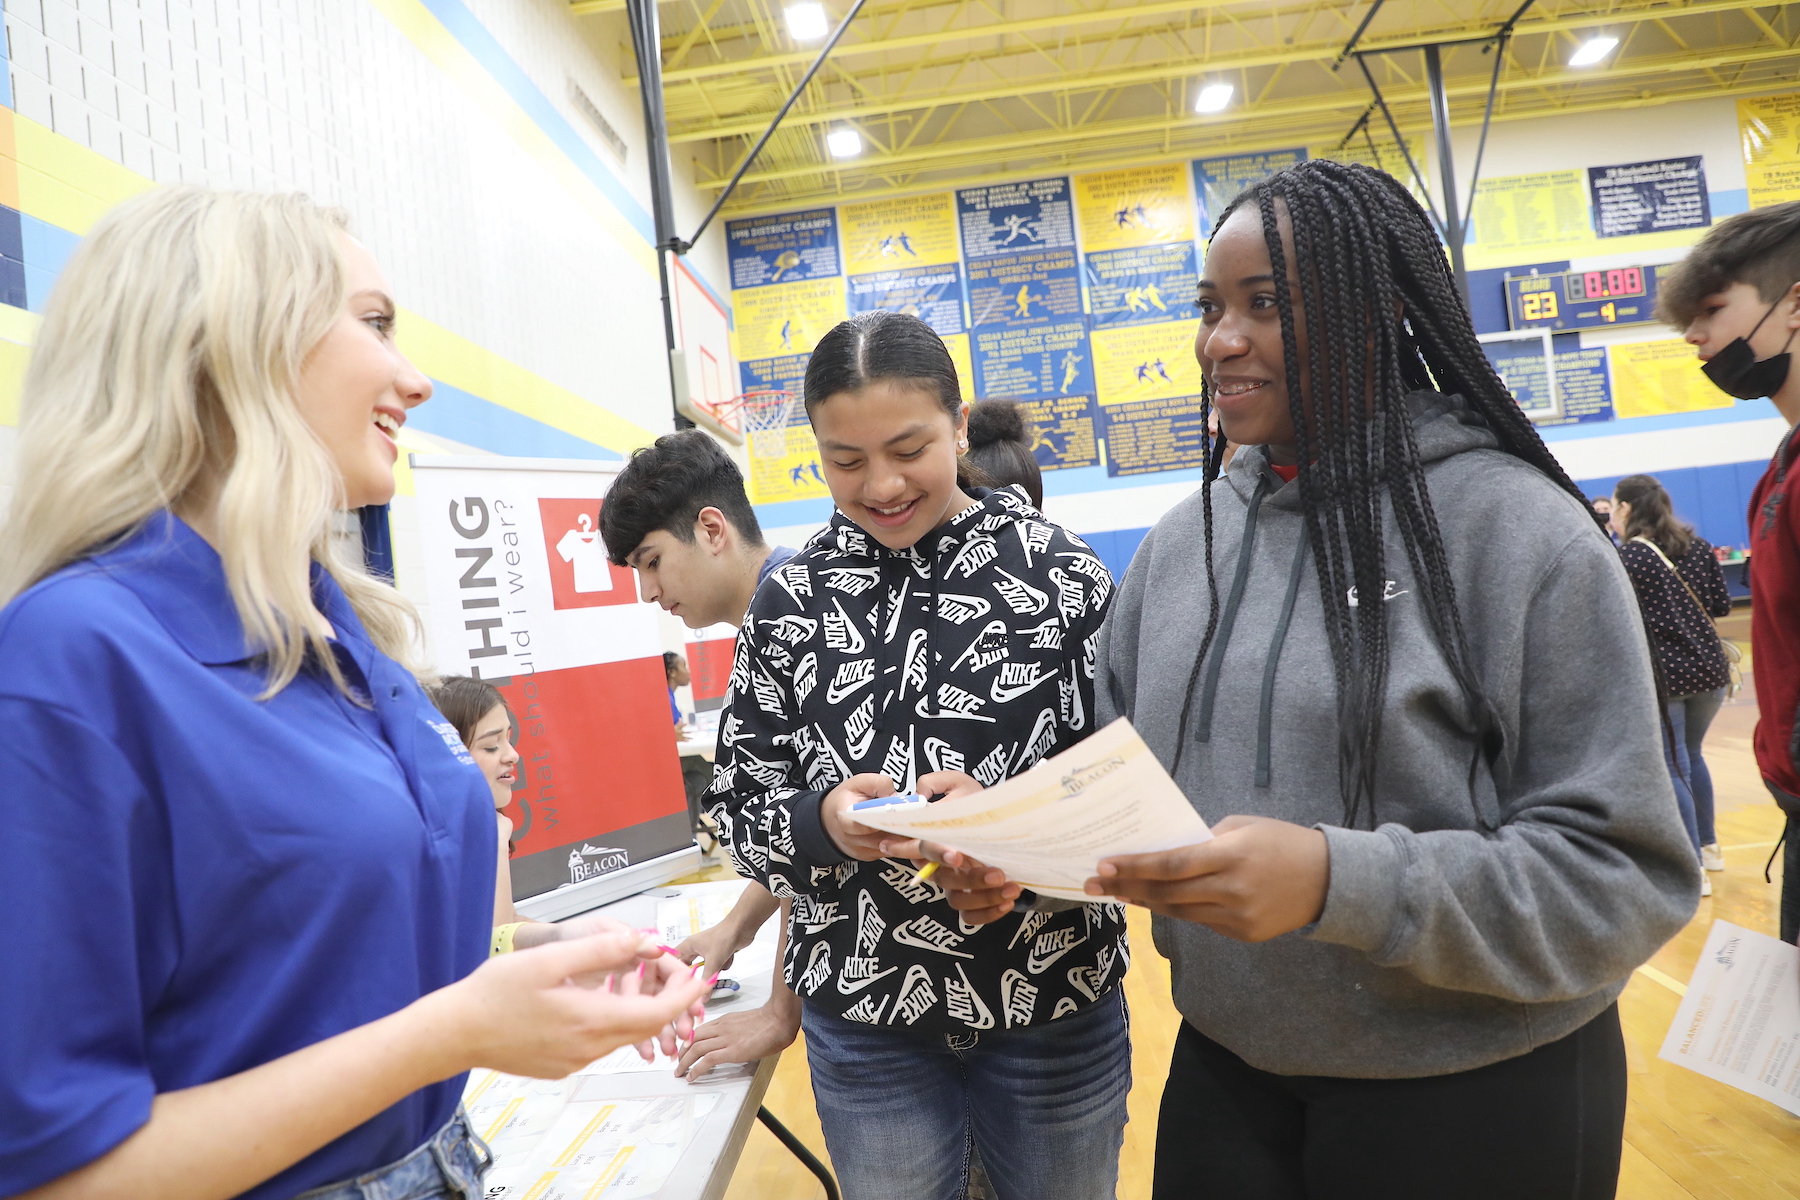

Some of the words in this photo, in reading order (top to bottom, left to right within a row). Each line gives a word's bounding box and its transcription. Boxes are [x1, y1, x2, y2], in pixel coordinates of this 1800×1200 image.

[751, 223, 791, 235] DISTRICT
[793, 218, 831, 231] CHAMPS
[991, 264, 1033, 277] DISTRICT
[1035, 259, 1075, 271] CHAMPS
[1018, 254, 1044, 263] JUNIOR
[1045, 251, 1073, 259] SCHOOL
[917, 273, 956, 286] CHAMPS
[1522, 291, 1558, 320] 23
[1600, 302, 1616, 323] 4
[1000, 336, 1042, 348] DISTRICT
[1044, 331, 1085, 343] CHAMPS
[1028, 326, 1054, 335] JUNIOR
[1055, 322, 1083, 332] SCHOOL
[1126, 409, 1159, 421] DISTRICT
[494, 499, 524, 595] wear?
[1028, 523, 1054, 554] NIKE
[960, 541, 1000, 578] NIKE
[786, 564, 814, 597] NIKE
[825, 571, 872, 597] NIKE
[992, 580, 1038, 615] NIKE
[1061, 577, 1084, 619] NIKE
[822, 612, 848, 648] NIKE
[510, 631, 544, 737] should
[1000, 661, 1041, 685] NIKE
[752, 670, 784, 715] NIKE
[740, 760, 787, 788] NIKE
[531, 750, 560, 831] what
[573, 851, 629, 882] BEACON
[860, 906, 887, 956] NIKE
[911, 915, 965, 948] NIKE
[1034, 926, 1076, 956] NIKE
[805, 953, 832, 996] NIKE
[844, 956, 879, 979] NIKE
[901, 981, 939, 1025] NIKE
[944, 977, 974, 1022] NIKE
[1011, 980, 1038, 1025] NIKE
